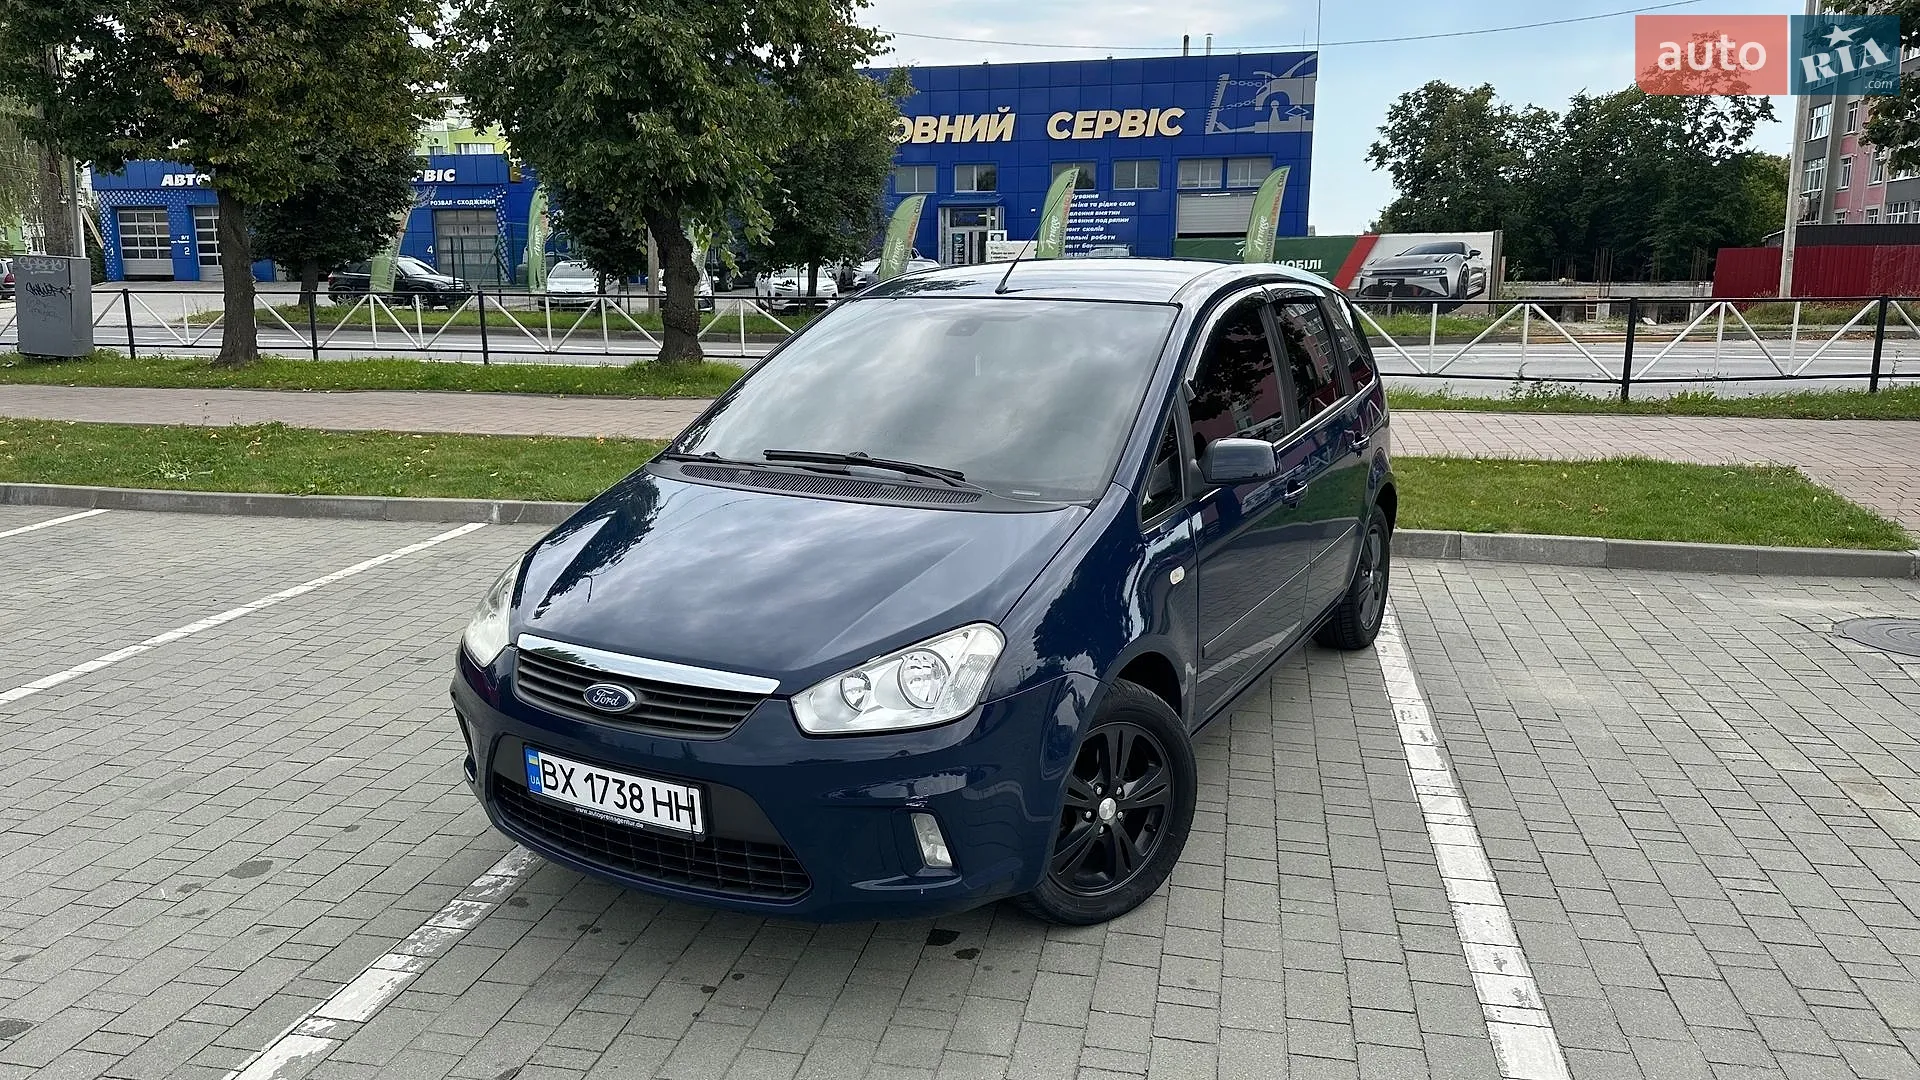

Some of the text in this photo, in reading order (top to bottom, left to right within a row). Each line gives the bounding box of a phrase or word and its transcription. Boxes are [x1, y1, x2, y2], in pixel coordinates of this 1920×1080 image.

[1046, 107, 1187, 140] СЕРВІС
[184, 247, 190, 255] 2
[427, 245, 433, 254] 4
[592, 689, 621, 706] Ford
[530, 775, 541, 786] UA
[541, 758, 697, 826] BX 1738 HH
